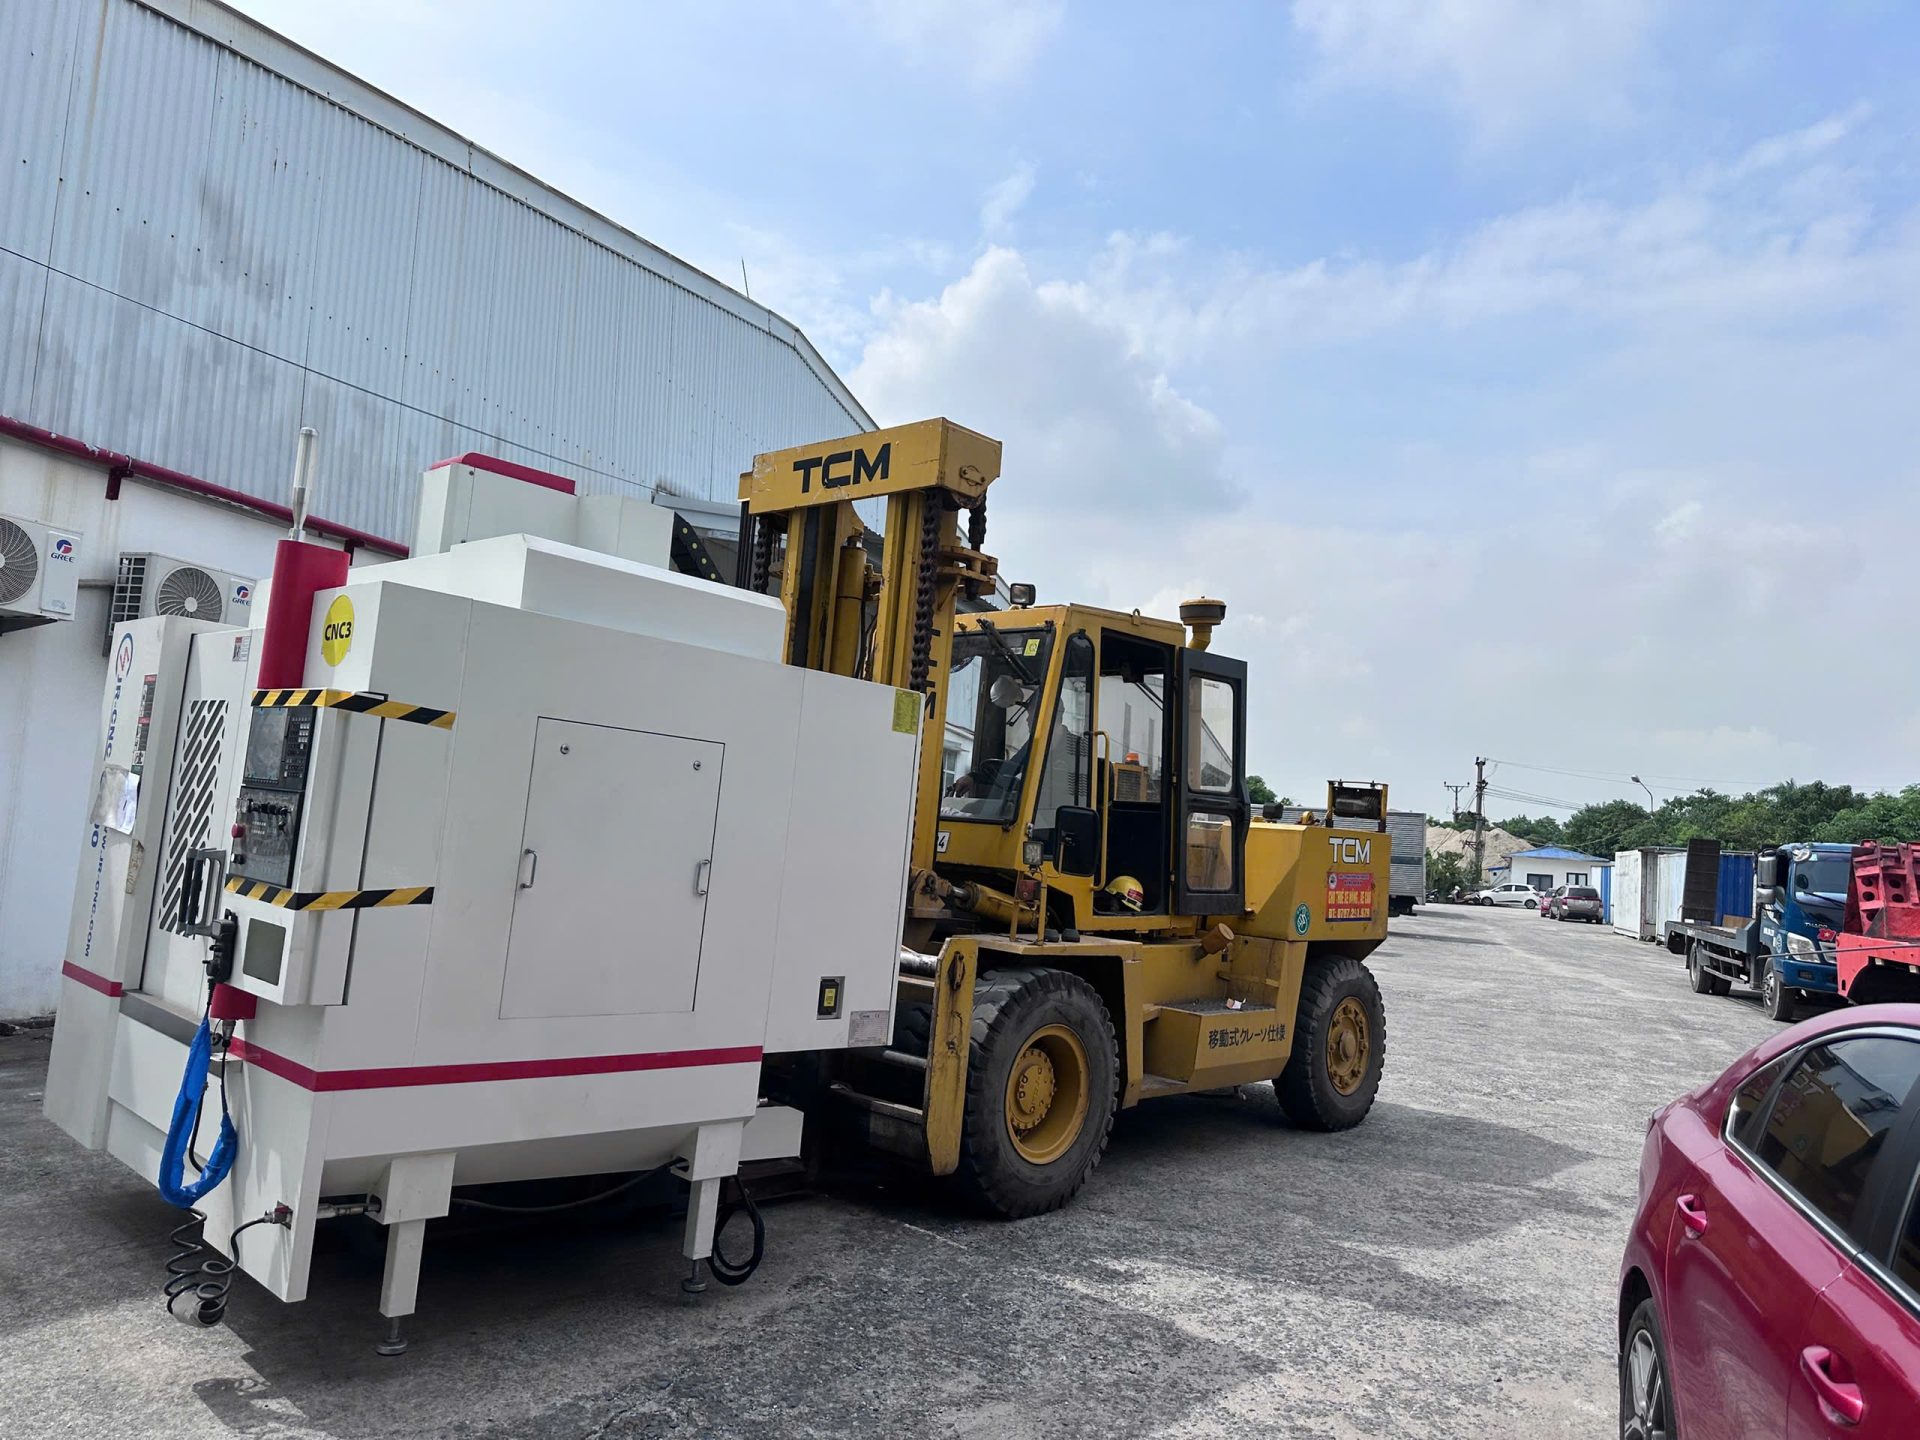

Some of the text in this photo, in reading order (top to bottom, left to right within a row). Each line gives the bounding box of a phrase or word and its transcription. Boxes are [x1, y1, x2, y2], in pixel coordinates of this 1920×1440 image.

[793, 443, 891, 493] TCM
[51, 552, 75, 563] GREE
[325, 621, 352, 641] CNC3
[105, 675, 122, 758] JR-CNC
[1328, 836, 1371, 864] TCM
